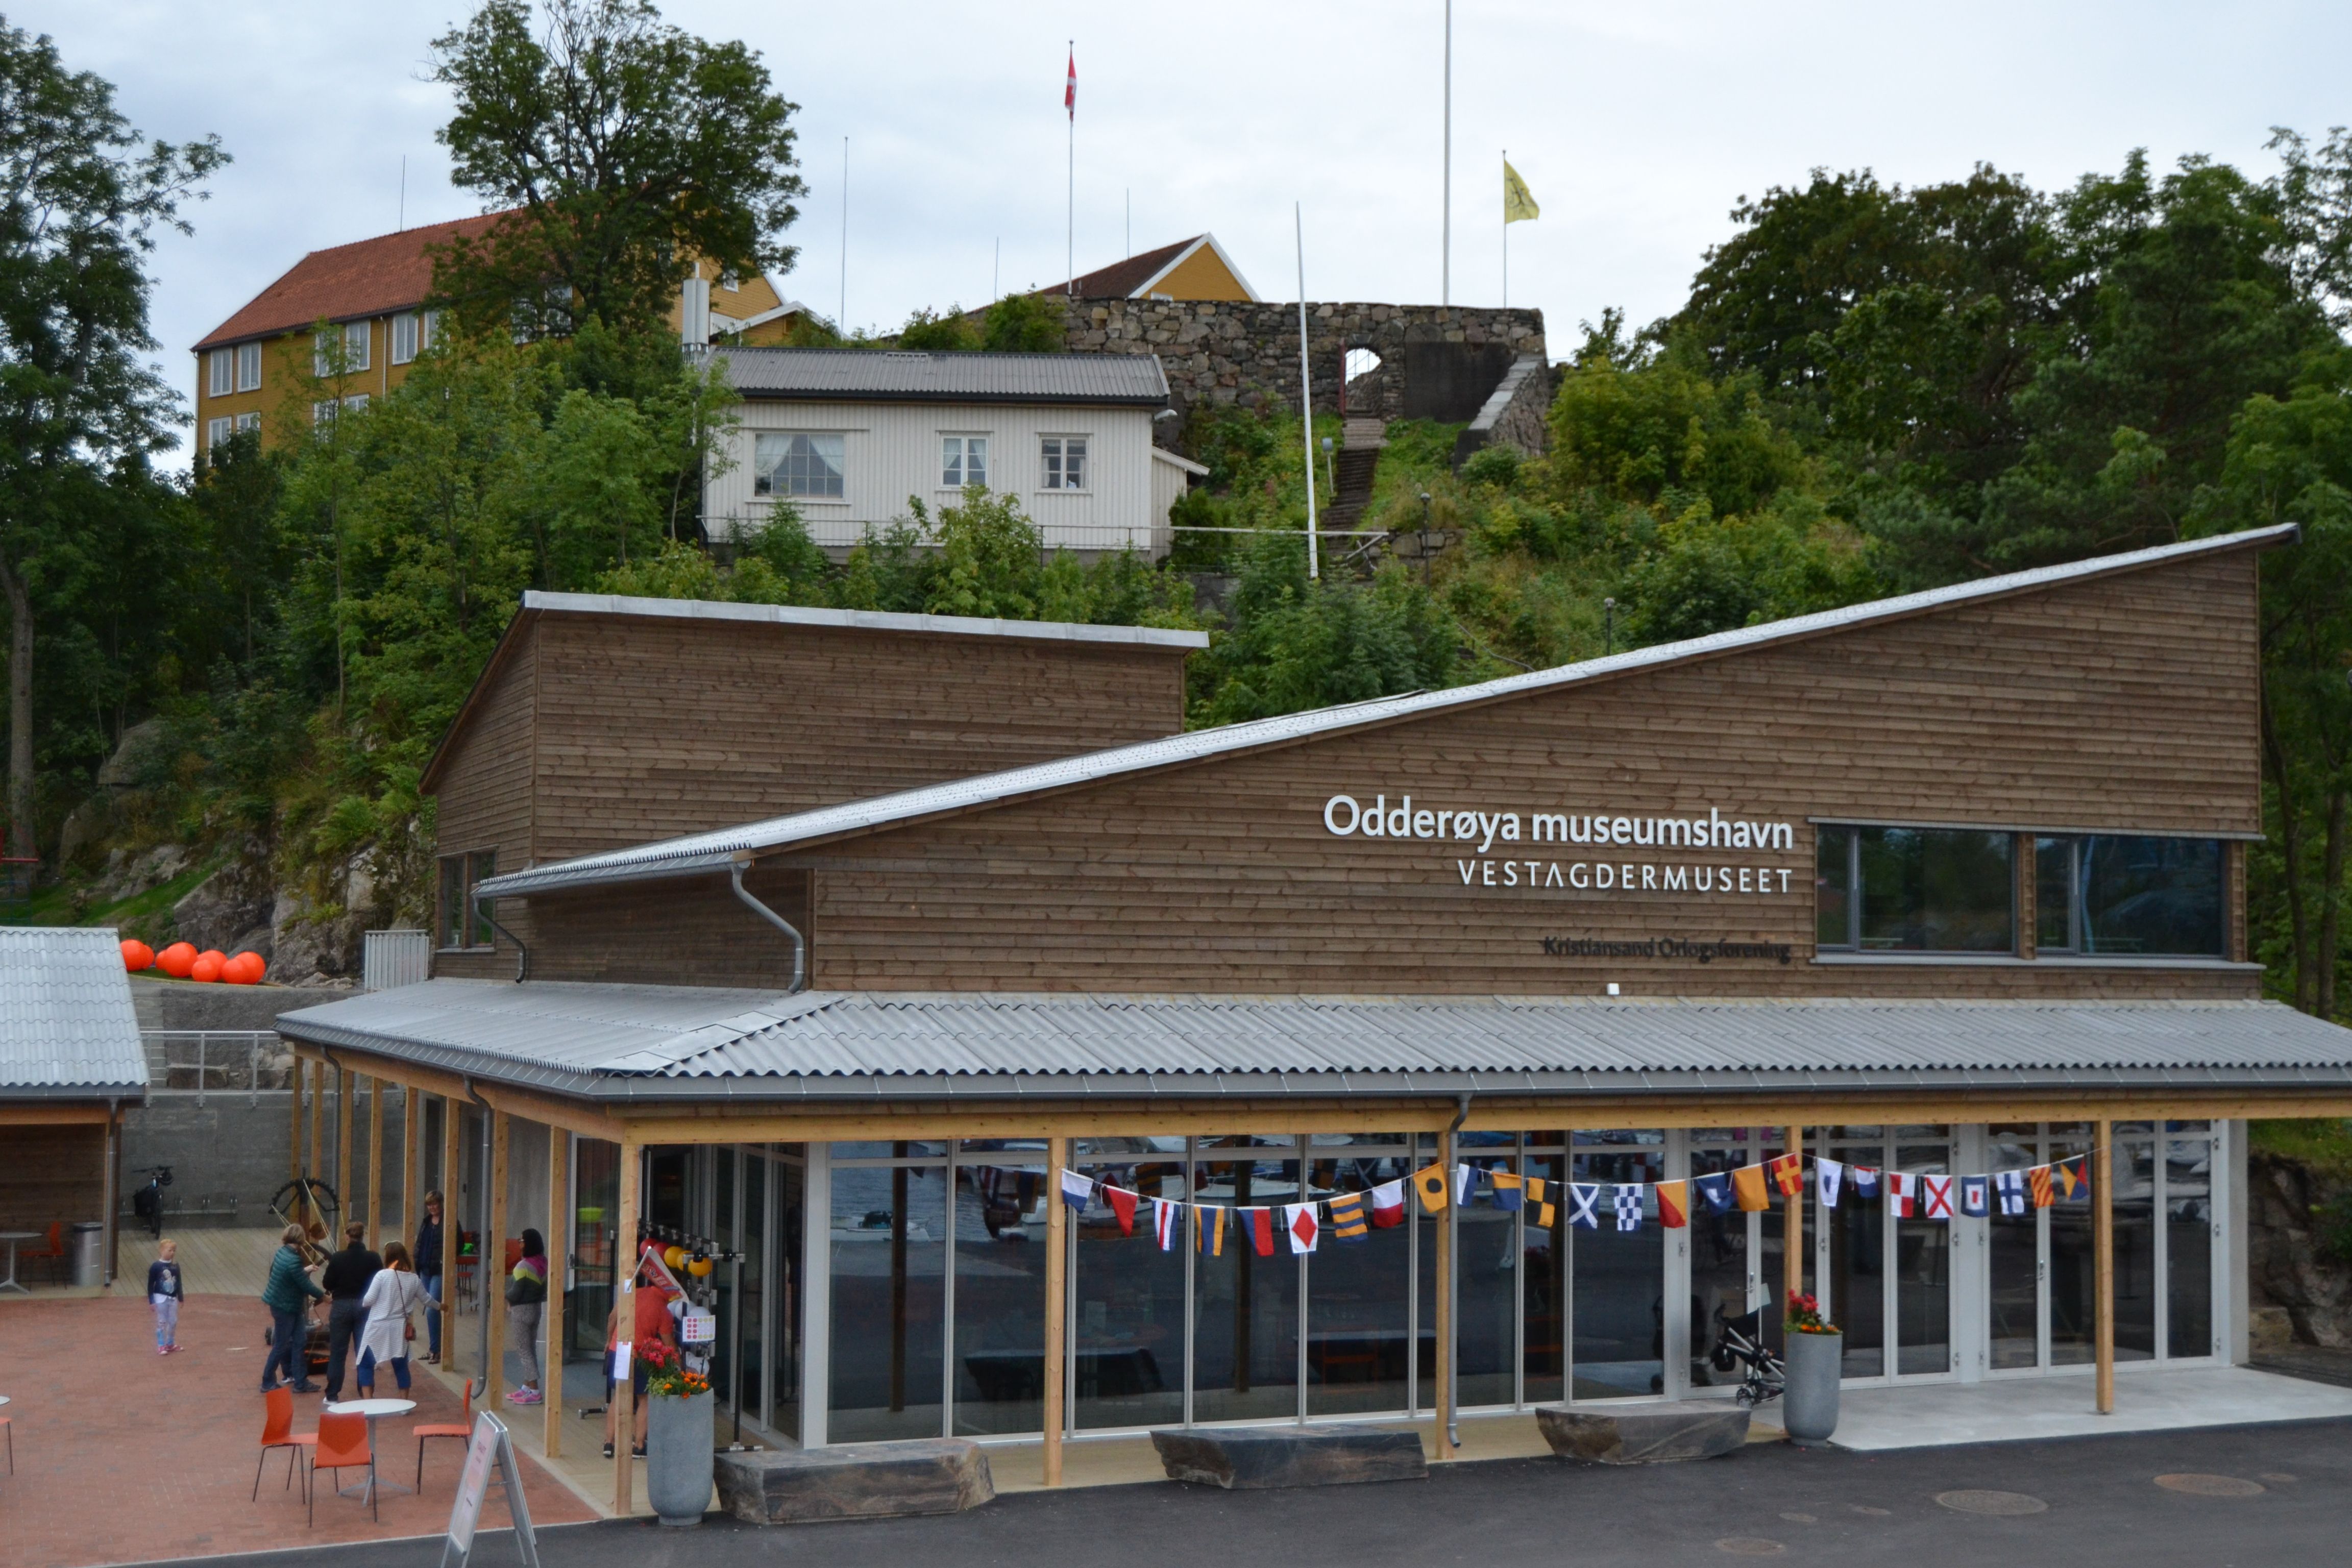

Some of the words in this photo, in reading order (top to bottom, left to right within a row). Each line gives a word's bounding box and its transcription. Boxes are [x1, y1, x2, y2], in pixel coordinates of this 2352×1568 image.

[1324, 794, 1520, 852] Odderøya
[1532, 807, 1793, 849] museumshavn
[1457, 860, 1792, 893] VESTAGDERMUSEET
[1544, 936, 1655, 956] Kristiansand
